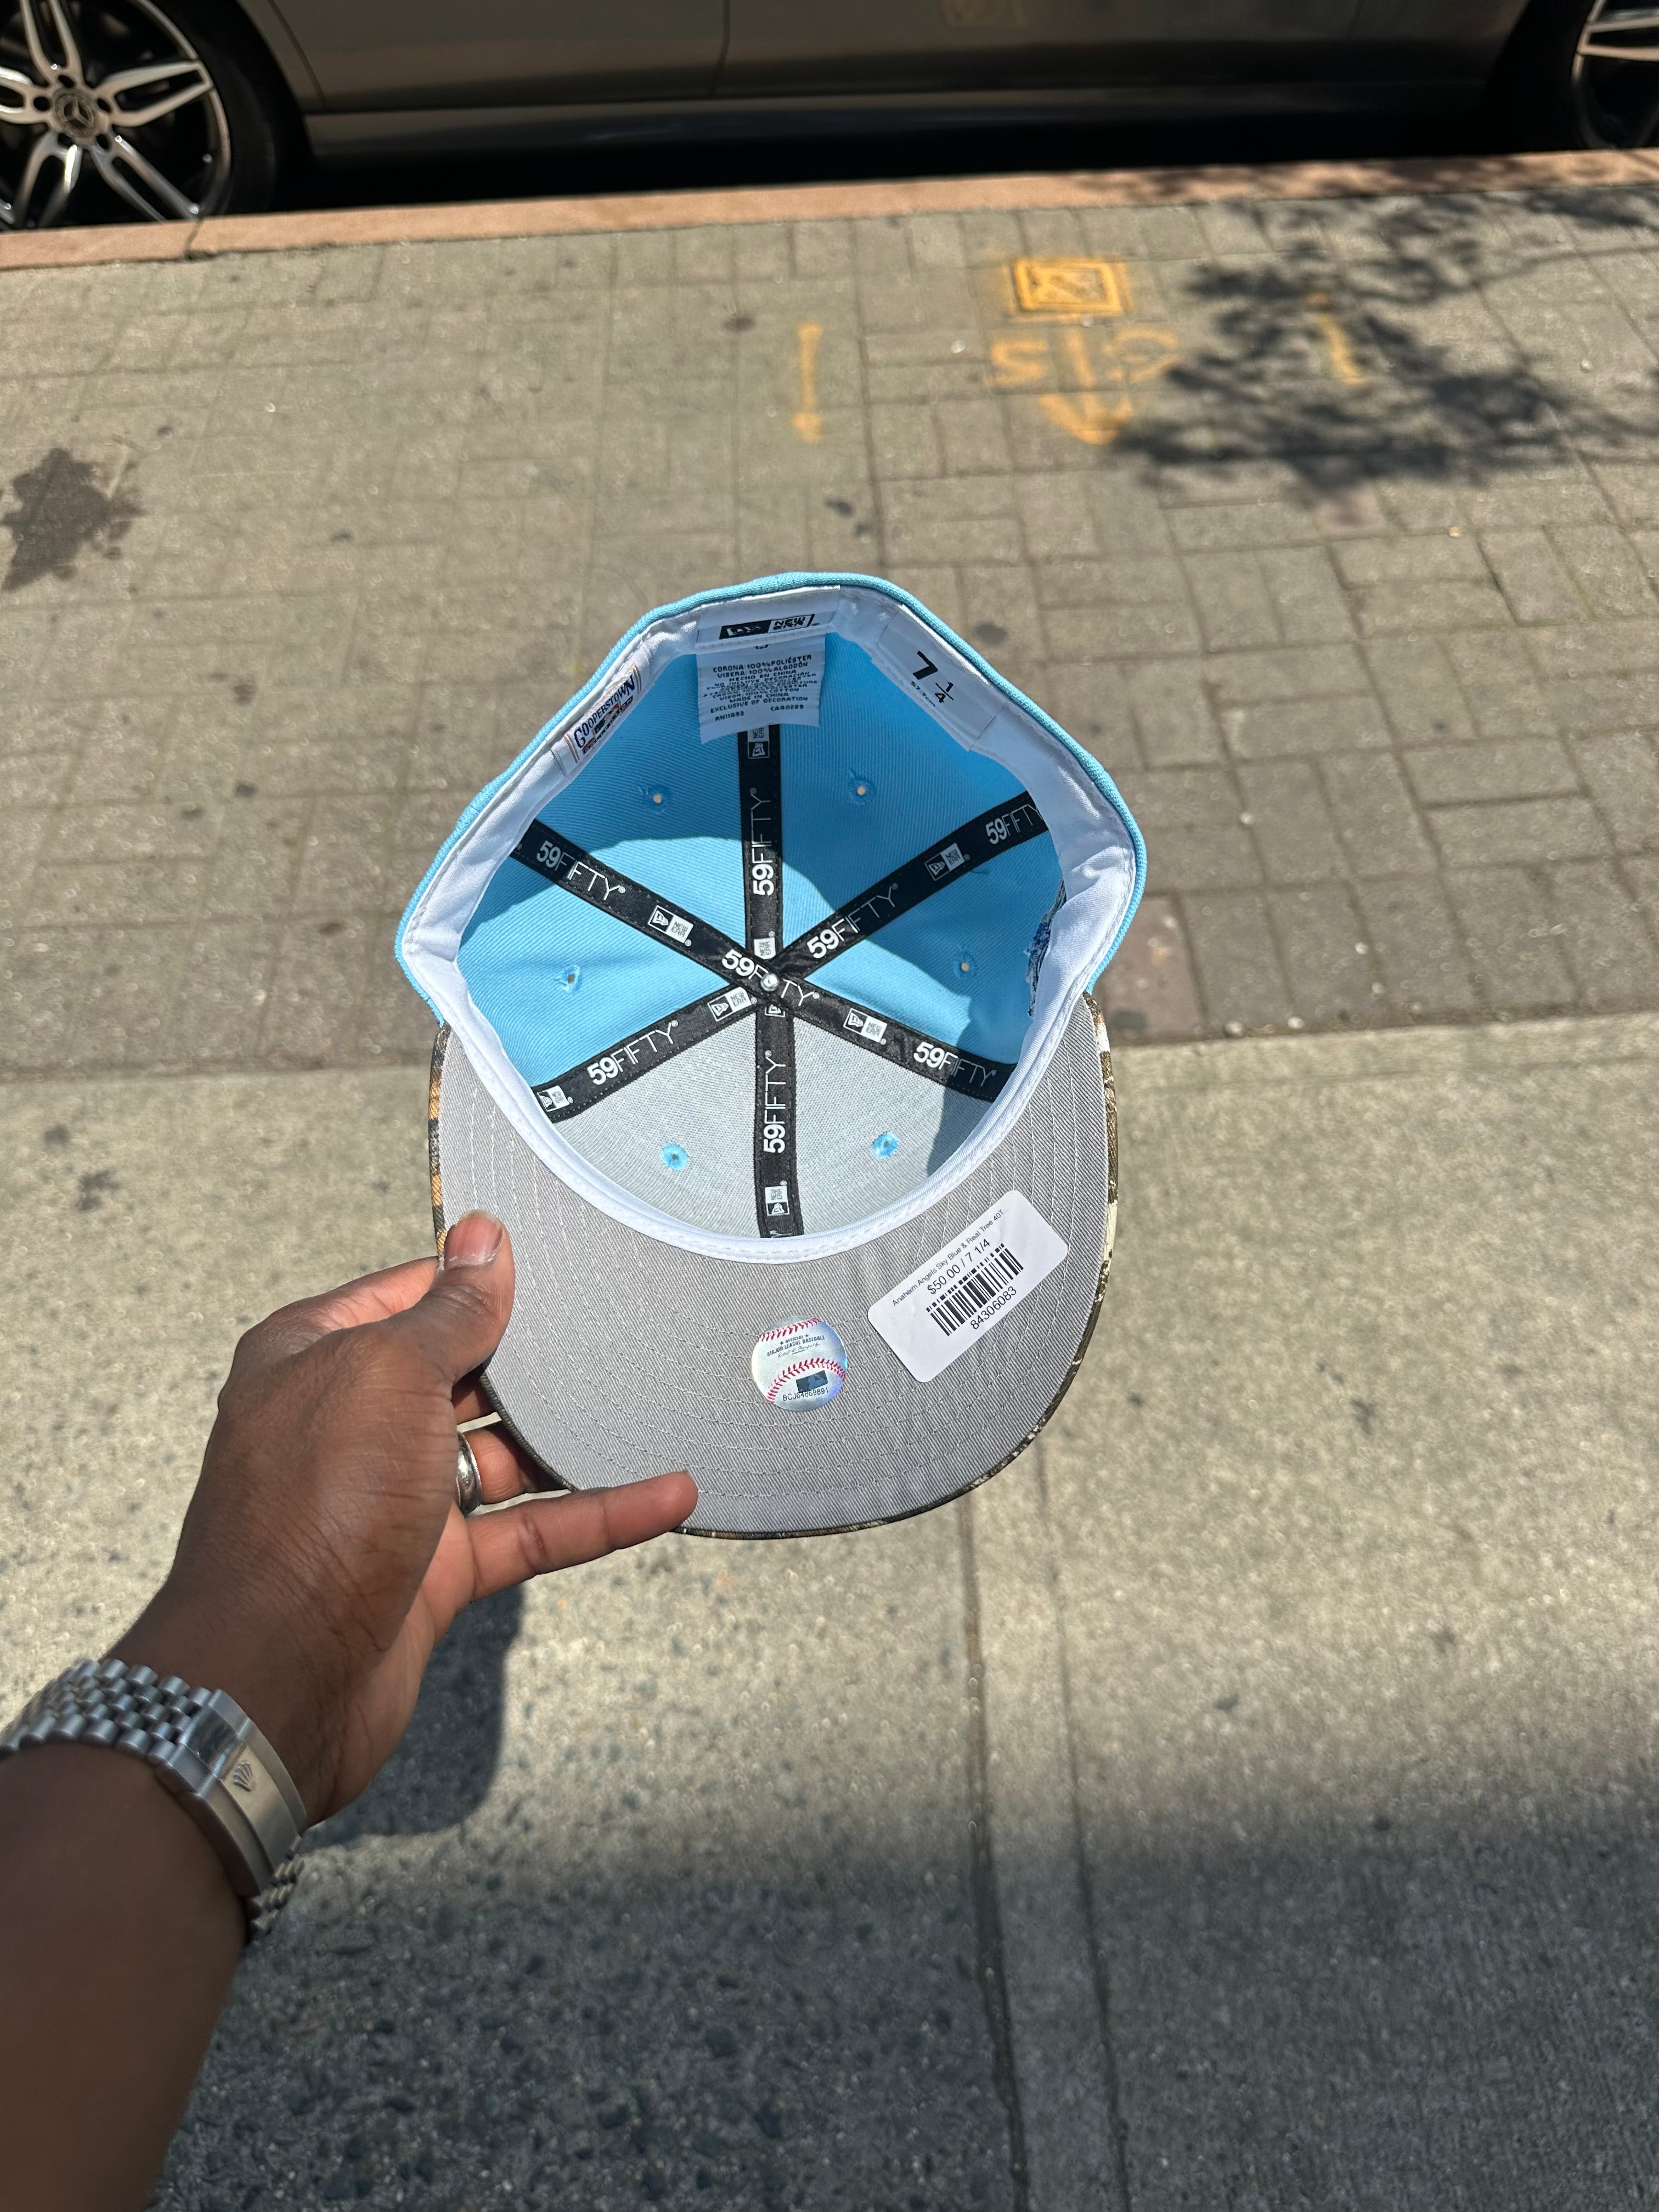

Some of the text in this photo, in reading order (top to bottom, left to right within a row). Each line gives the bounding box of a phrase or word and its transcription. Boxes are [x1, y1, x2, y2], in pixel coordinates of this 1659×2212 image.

[774, 617, 806, 626] NEW
[913, 651, 938, 680] 7
[574, 674, 635, 748] COOPERSTOWN
[710, 702, 748, 713] EXCLUSIVE
[893, 1284, 918, 1306] Anaheim
[918, 1268, 937, 1285] Angels
[936, 1259, 949, 1269] Sky
[947, 1247, 962, 1260] Blue
[966, 1231, 981, 1244] Real
[979, 1220, 993, 1232] Tree
[928, 1265, 961, 1294] $50.00
[964, 1252, 973, 1262] 7
[974, 1239, 991, 1254] 1/4
[970, 1286, 1017, 1330] 84306083
[767, 1346, 783, 1357] MAJOR
[784, 1340, 802, 1349] LEAGUE
[802, 1335, 825, 1344] BASEBALL
[785, 1335, 804, 1344] OFFICIAL
